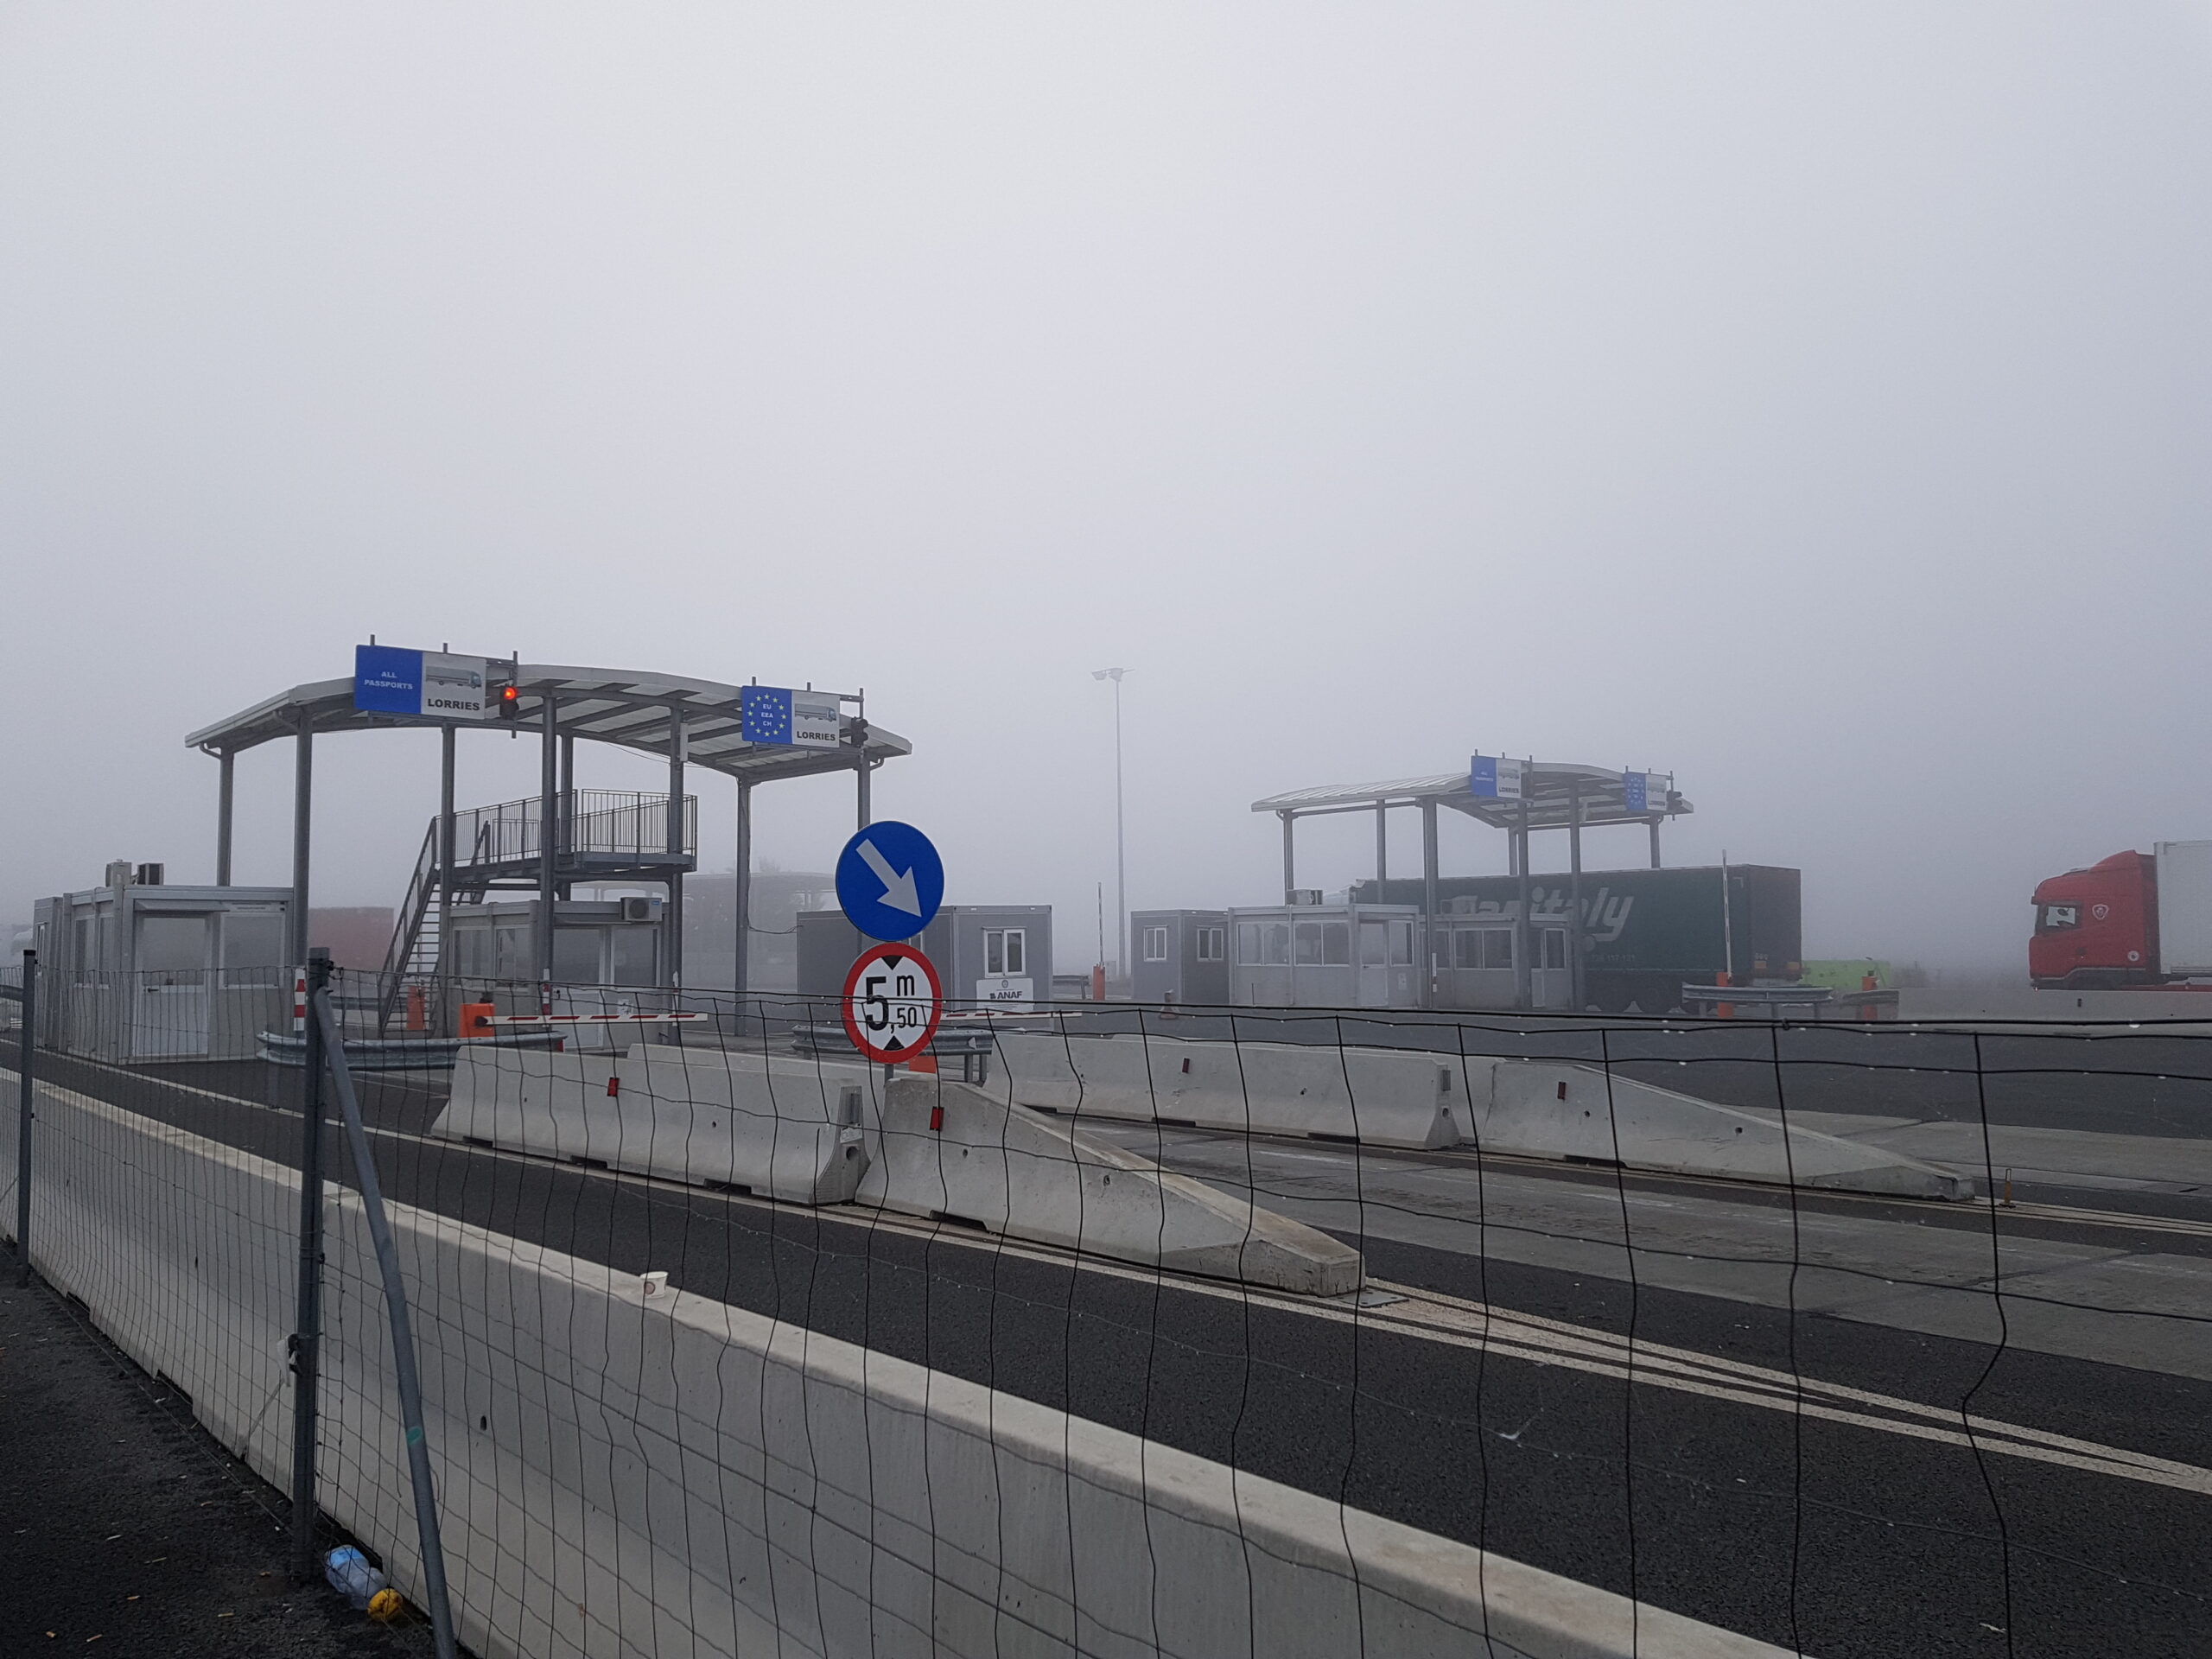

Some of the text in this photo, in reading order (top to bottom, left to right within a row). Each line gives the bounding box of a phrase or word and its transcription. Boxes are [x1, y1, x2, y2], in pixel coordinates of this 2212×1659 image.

[364, 679, 413, 690] PASSPORTS
[427, 698, 480, 711] LORRIES
[796, 730, 836, 741] LORRIES
[997, 990, 1023, 1000] ANAF
